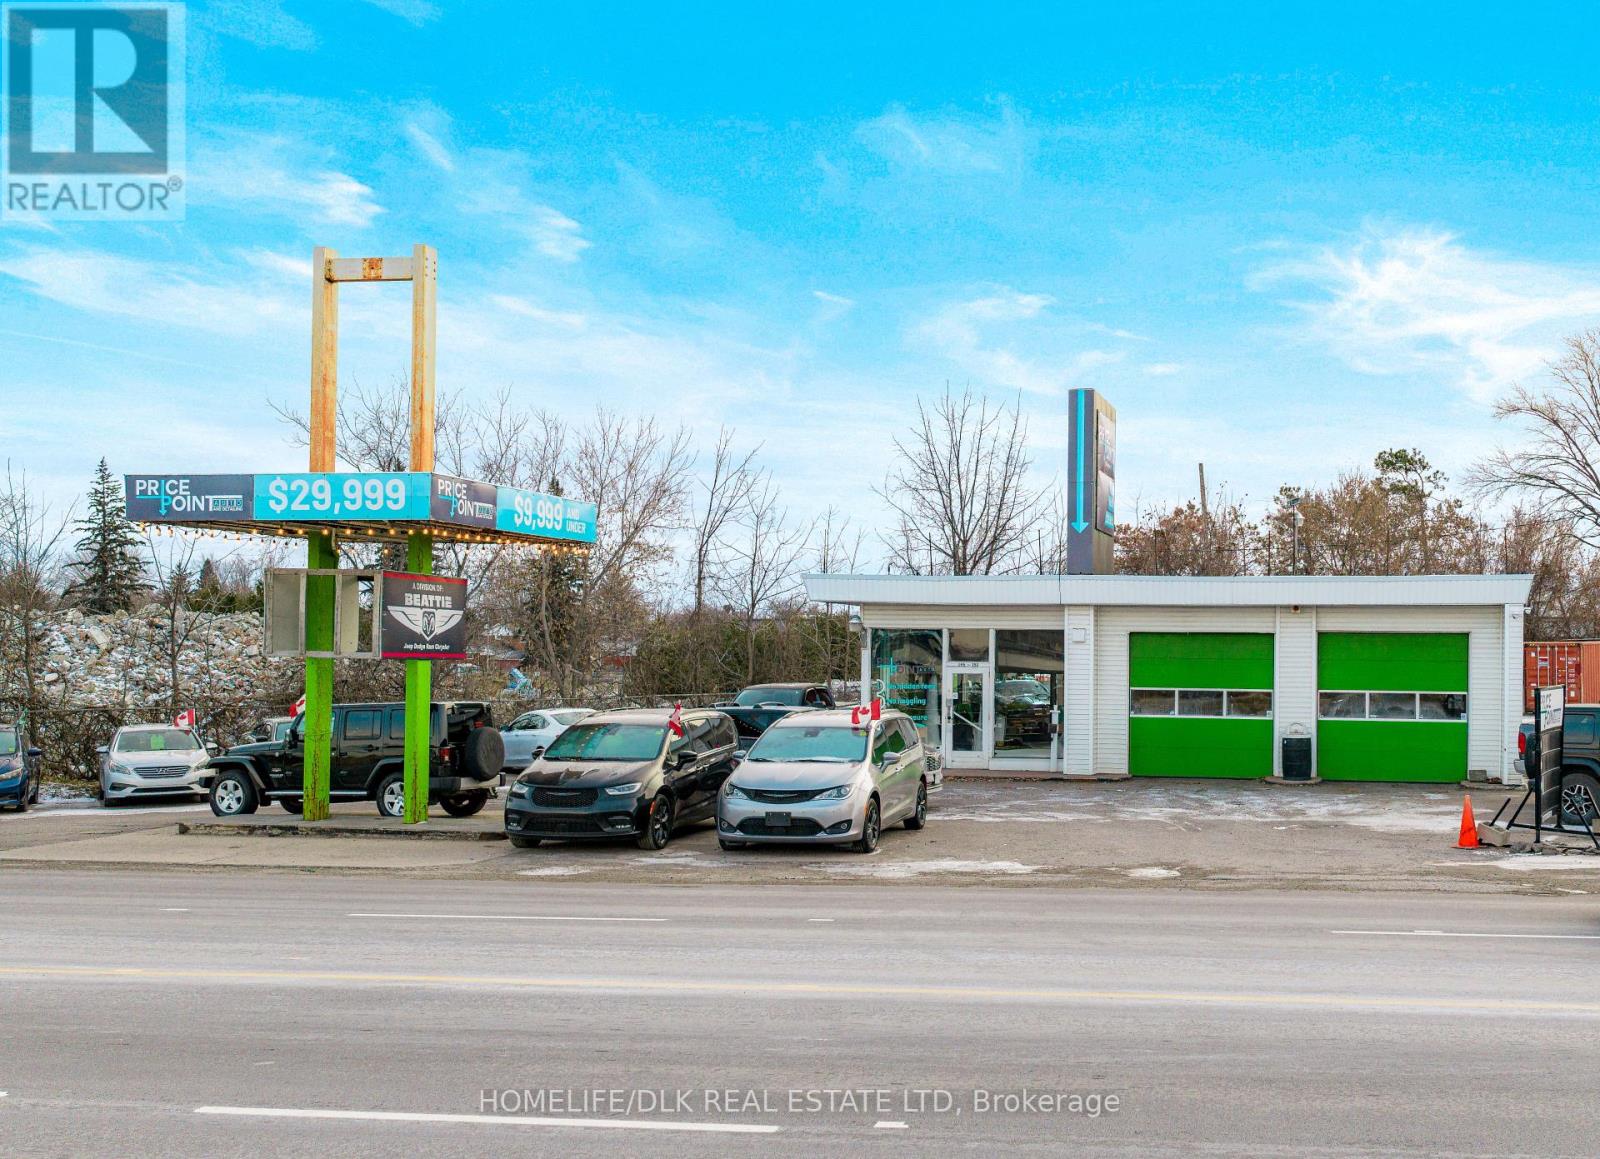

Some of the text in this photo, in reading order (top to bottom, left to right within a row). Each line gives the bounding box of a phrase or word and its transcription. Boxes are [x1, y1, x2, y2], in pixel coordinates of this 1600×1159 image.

[135, 479, 191, 496] PRICE
[268, 476, 406, 514] $29,999
[437, 478, 468, 500] PRICE
[514, 495, 563, 530] $9,999
[566, 520, 586, 534] UNDER
[404, 592, 453, 608] BEATTIE
